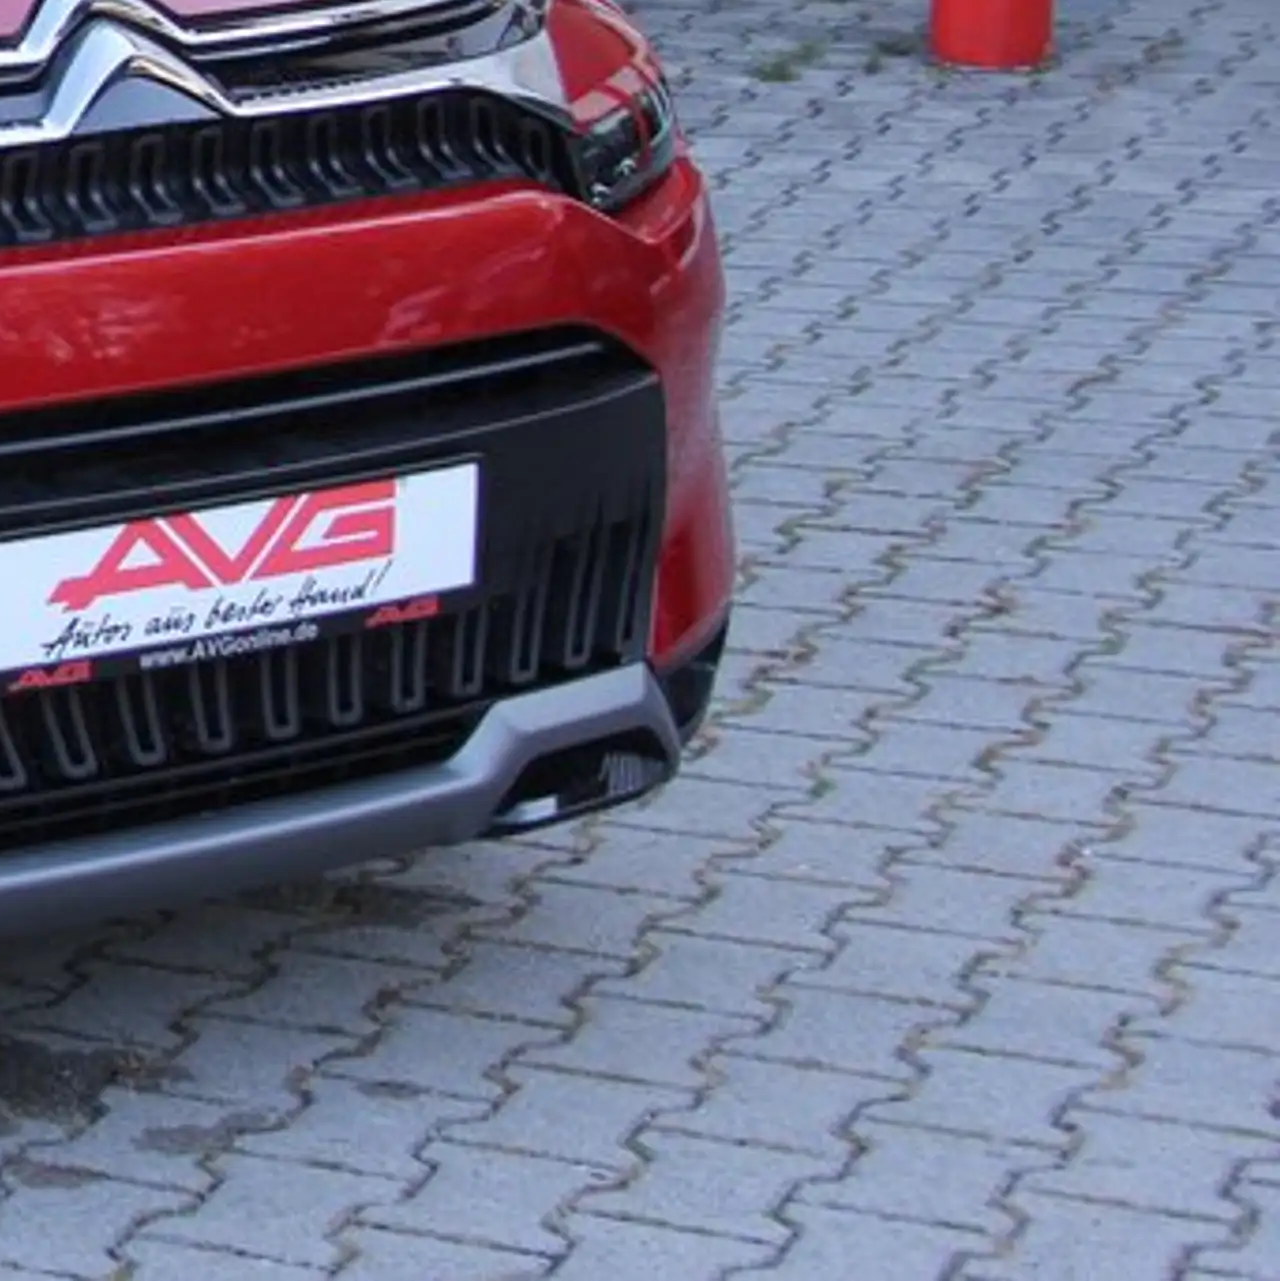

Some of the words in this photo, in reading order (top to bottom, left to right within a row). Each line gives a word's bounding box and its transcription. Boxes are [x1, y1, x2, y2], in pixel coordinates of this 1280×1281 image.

[47, 477, 396, 610] AVG
[204, 588, 283, 629] bester
[140, 621, 318, 669] www.AVGonline.de
